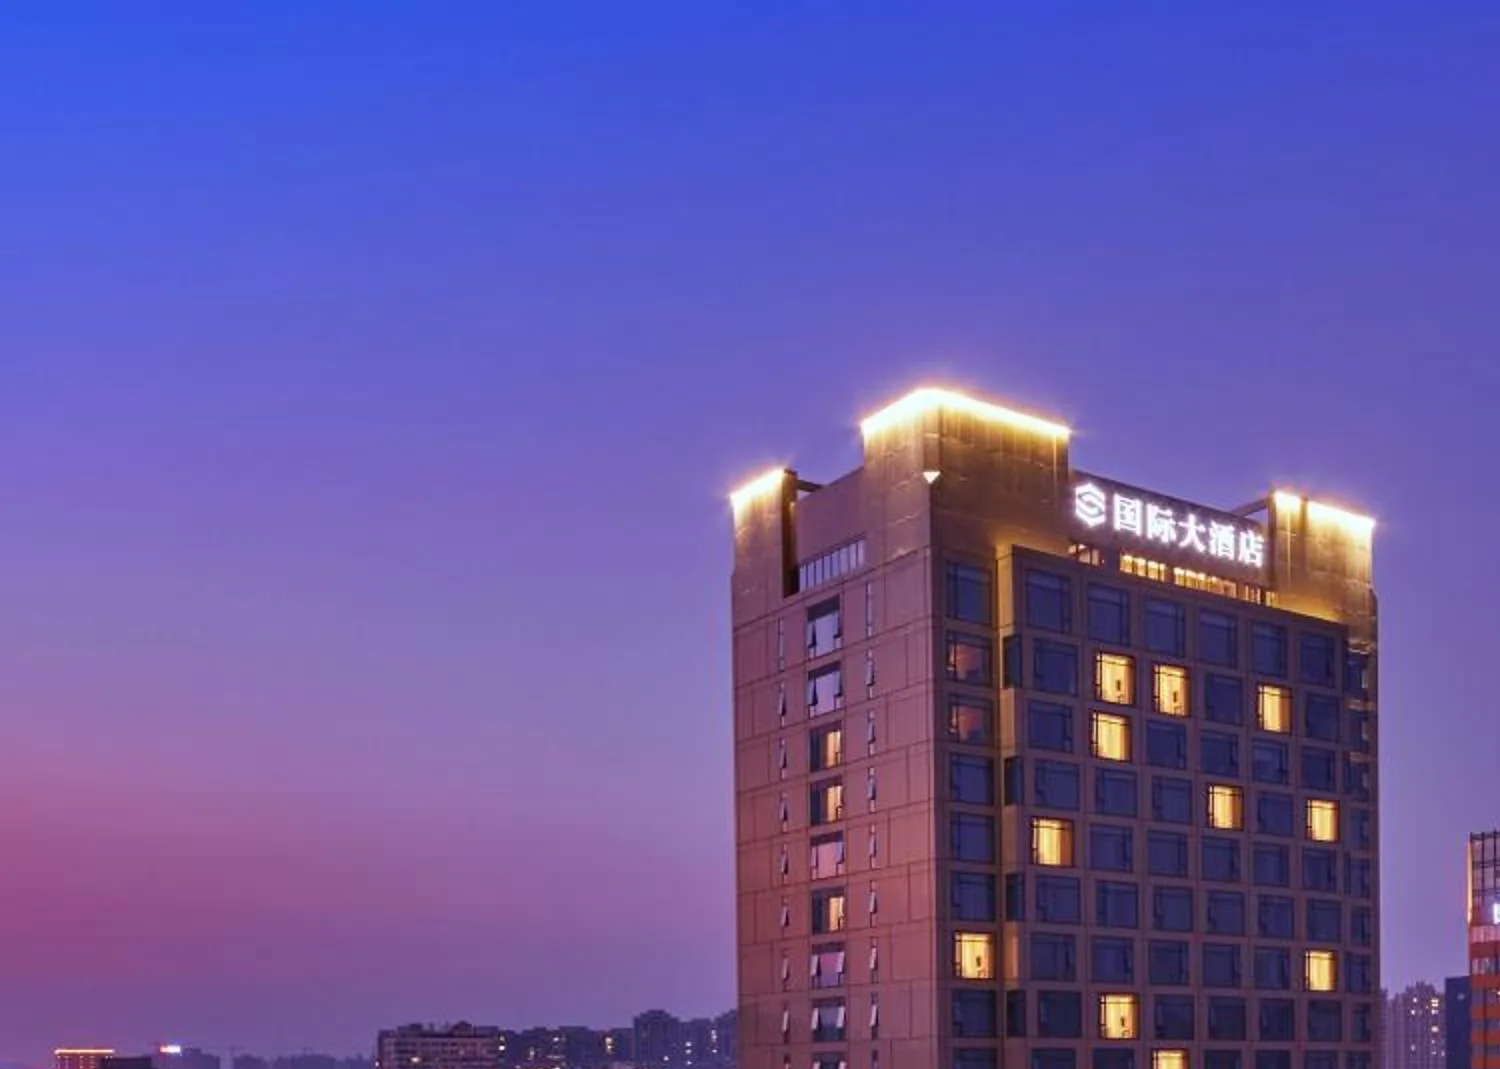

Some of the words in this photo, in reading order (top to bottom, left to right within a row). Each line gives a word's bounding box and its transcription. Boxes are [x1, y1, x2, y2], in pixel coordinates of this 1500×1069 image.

[1112, 493, 1266, 567] 国际大酒店
